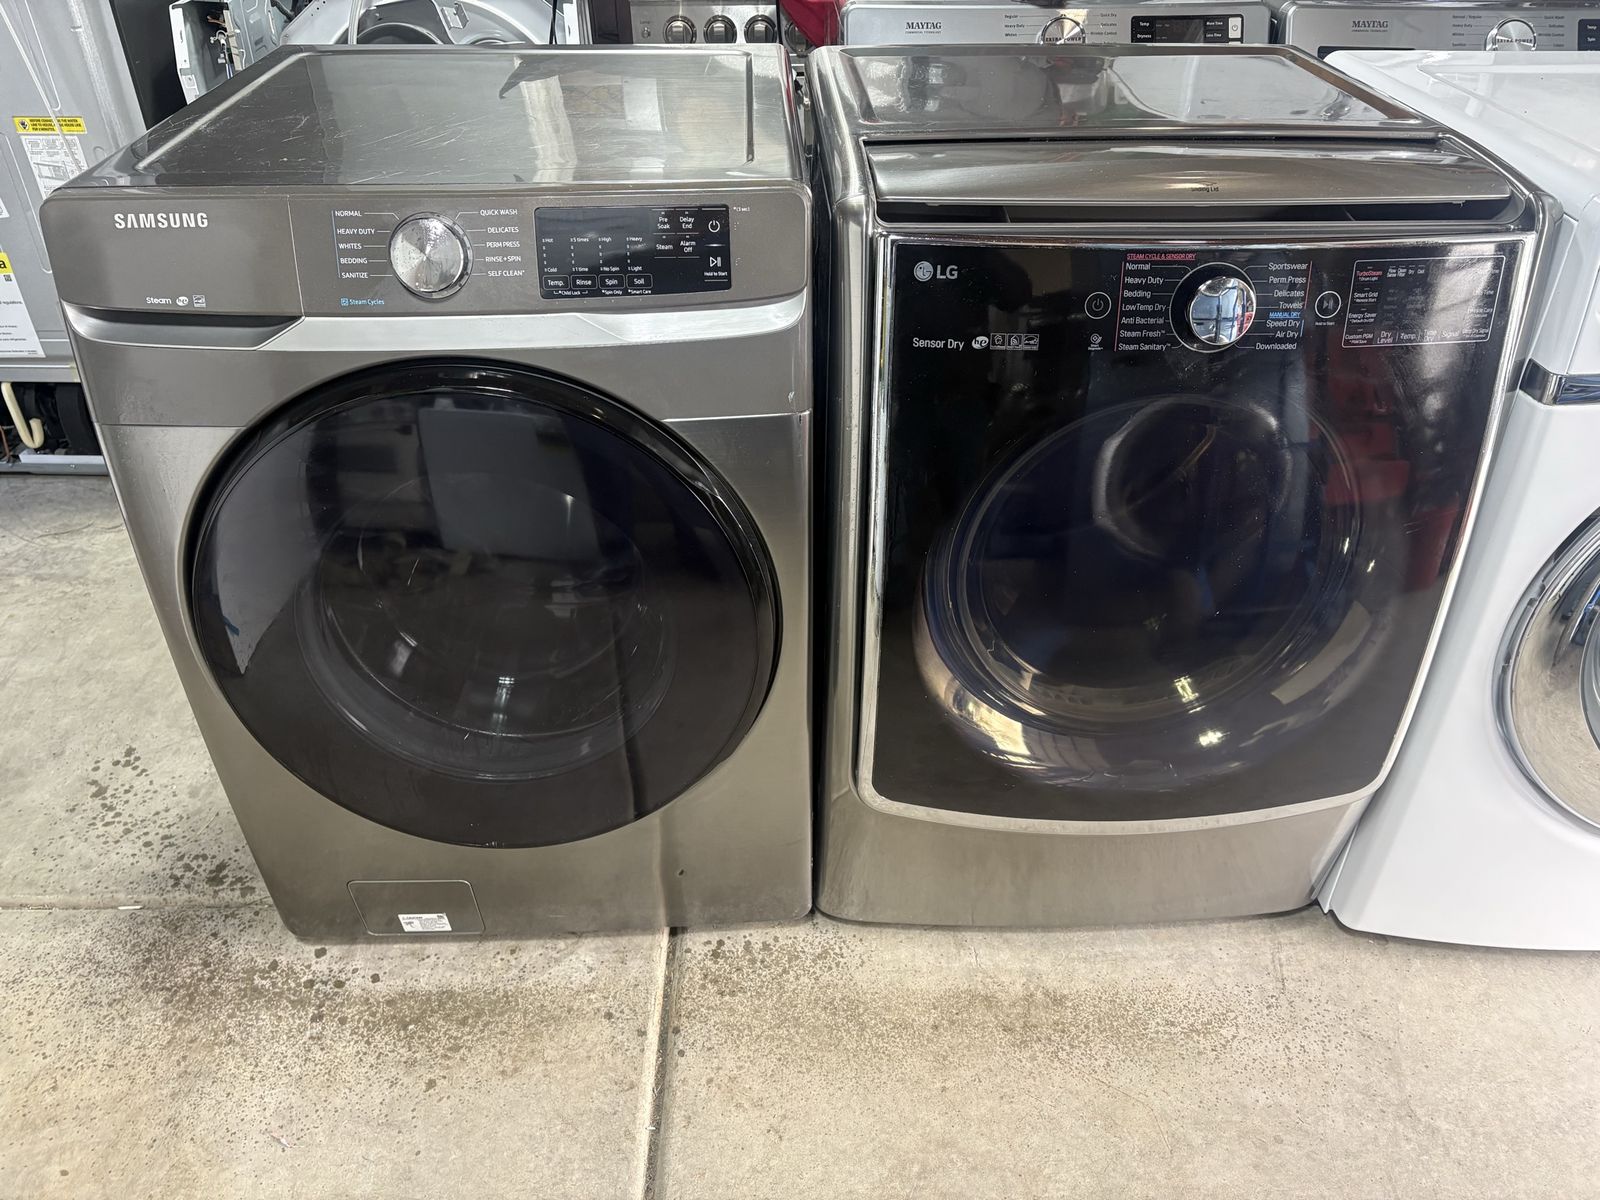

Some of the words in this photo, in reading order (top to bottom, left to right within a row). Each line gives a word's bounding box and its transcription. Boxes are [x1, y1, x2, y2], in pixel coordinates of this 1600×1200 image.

[905, 21, 942, 30] MAYTAG
[1352, 20, 1388, 28] MAYTAG
[480, 209, 499, 217] QUICK
[500, 208, 518, 216] WASH
[114, 212, 209, 229] SAMSUNG
[487, 226, 519, 234] DELICATES
[340, 257, 368, 265] BEDDING
[1125, 262, 1151, 270] Normal
[1268, 262, 1308, 271] Sportswear
[936, 264, 959, 280] LG
[547, 279, 565, 288] Temp.
[605, 278, 618, 286] Spin
[1124, 276, 1146, 285] Heavy
[1147, 276, 1164, 285] Duty
[1123, 289, 1151, 299] Bedding
[1273, 289, 1305, 297] Delicates
[146, 296, 172, 304] Steam
[1154, 303, 1166, 312] Dry
[1120, 316, 1135, 324] Anti
[1135, 316, 1165, 324] Bacterial
[1266, 320, 1287, 328] Speed
[1287, 320, 1301, 328] Dry
[1119, 329, 1141, 337] Steam
[1275, 330, 1286, 338] Air
[1286, 330, 1299, 339] Dry
[1380, 331, 1392, 339] Dry
[912, 337, 946, 349] Sensor
[947, 338, 965, 351] Dry
[1118, 343, 1139, 351] Steam
[1255, 342, 1297, 350] Downloaded
